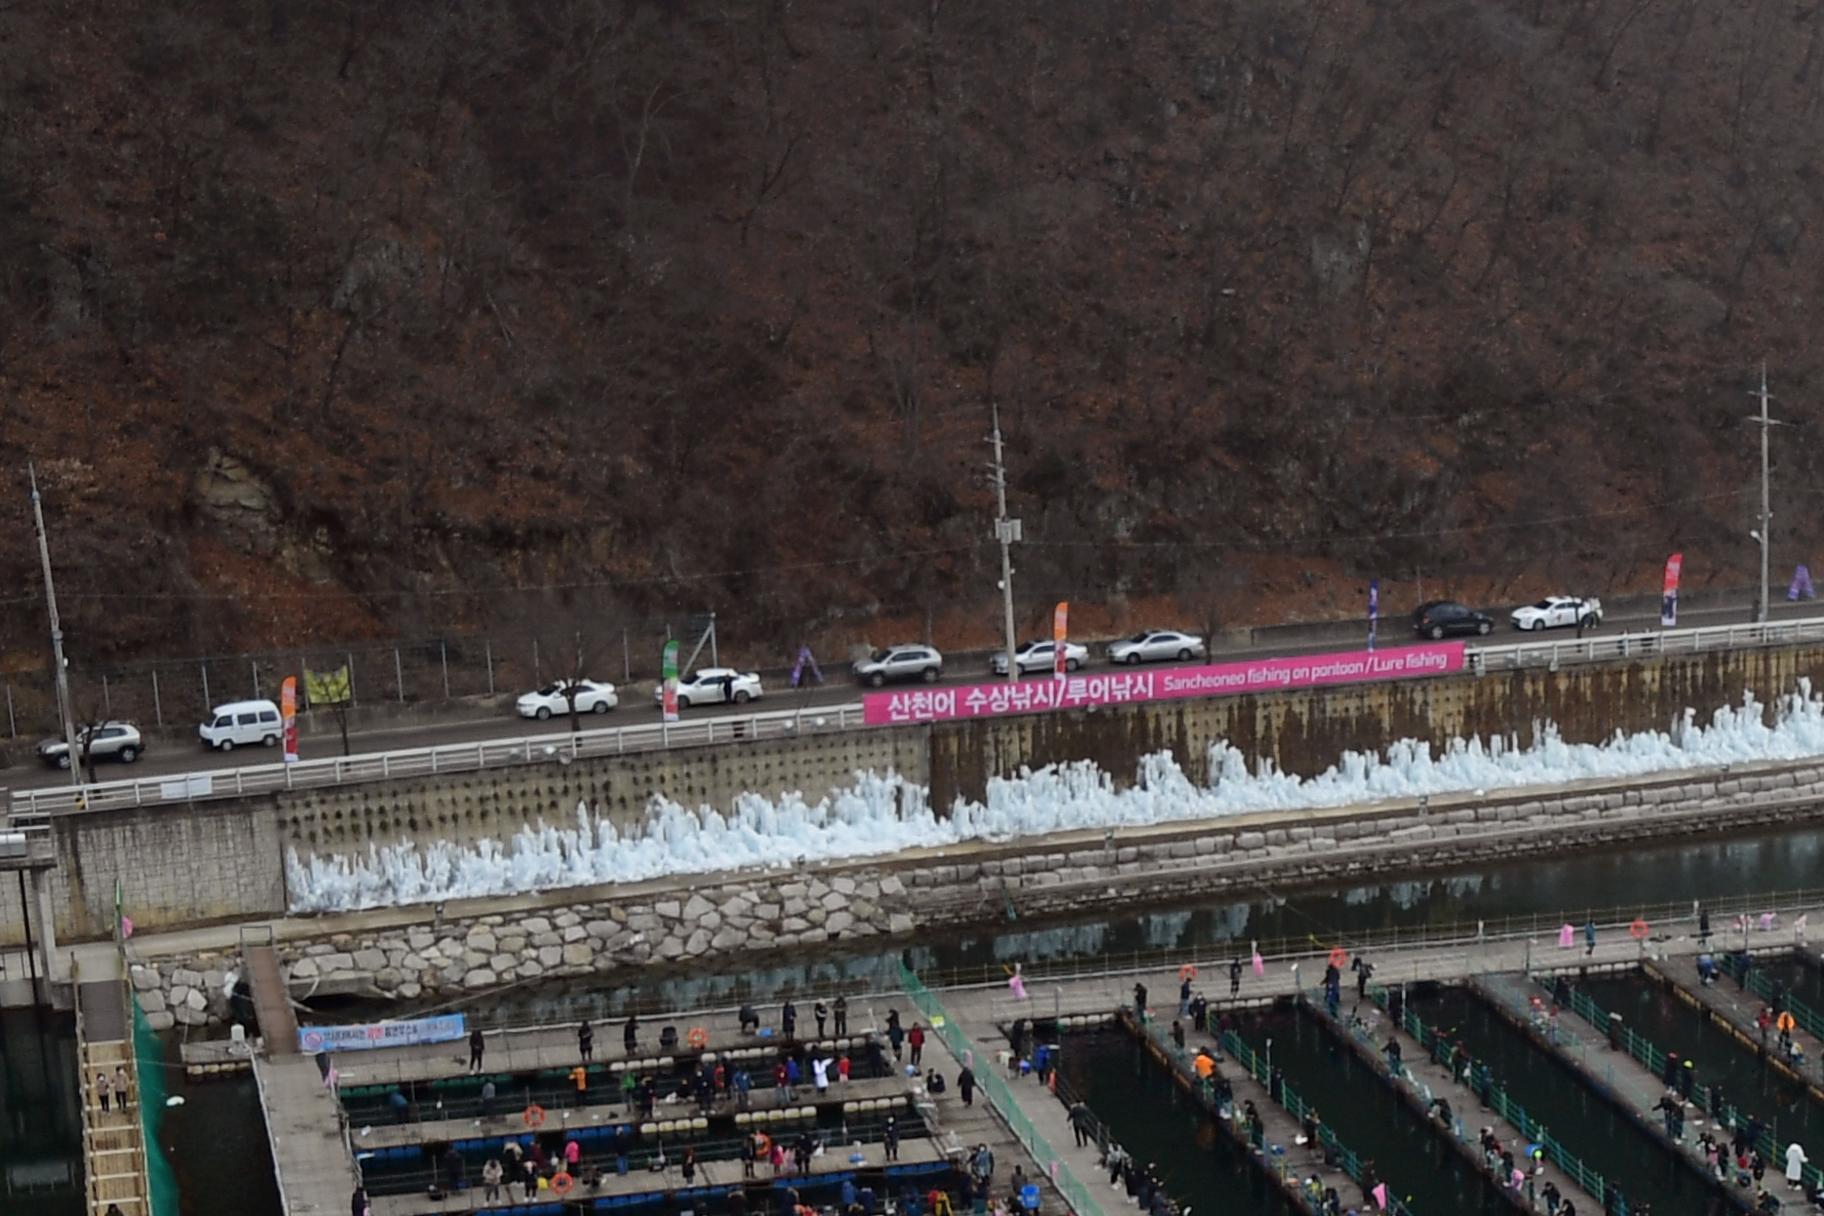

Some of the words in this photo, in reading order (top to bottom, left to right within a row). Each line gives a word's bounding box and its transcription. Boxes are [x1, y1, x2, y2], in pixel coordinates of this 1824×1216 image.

[1163, 669, 1245, 692] Sancheoneo
[1247, 666, 1290, 685] fishing
[1292, 667, 1310, 680] on
[1311, 661, 1364, 682] pontoon
[1405, 651, 1448, 671] fishing
[887, 690, 956, 721] 산천어
